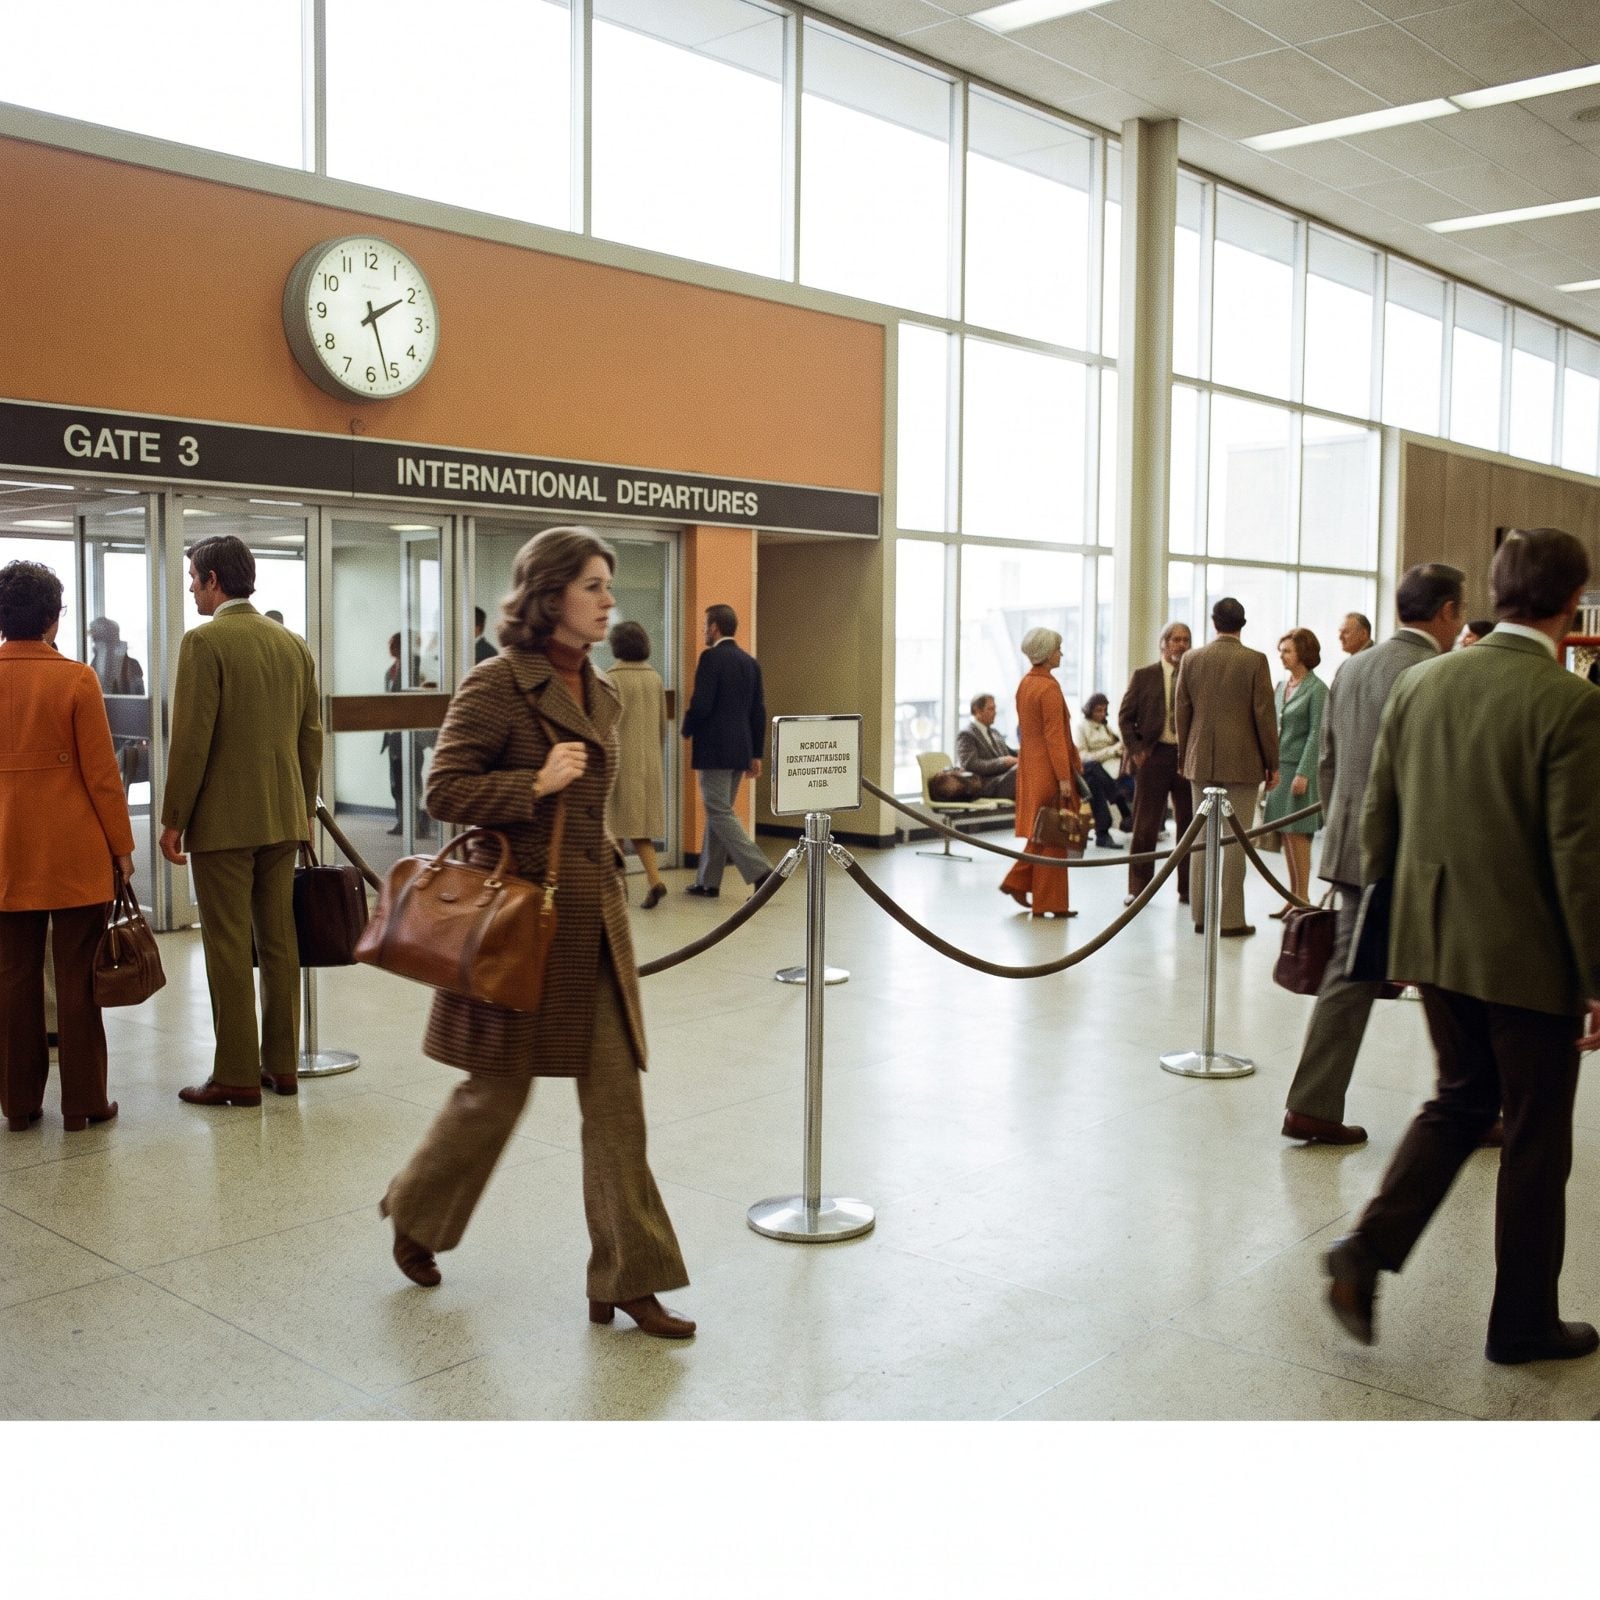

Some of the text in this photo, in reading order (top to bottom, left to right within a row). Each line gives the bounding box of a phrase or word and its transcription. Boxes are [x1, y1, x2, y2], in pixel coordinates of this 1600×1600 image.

[342, 256, 352, 273] 11
[364, 252, 378, 270] 12
[323, 273, 339, 292] 10
[407, 287, 416, 305] 2
[316, 301, 328, 319] 9
[414, 317, 423, 334] 3
[324, 332, 336, 350] 8
[406, 344, 416, 360] 4
[342, 356, 352, 373] 7
[390, 362, 400, 379] 5
[365, 366, 376, 383] 6
[63, 424, 200, 467] GATE 3
[397, 457, 759, 517] INTERNATIONAL DEPARTURES
